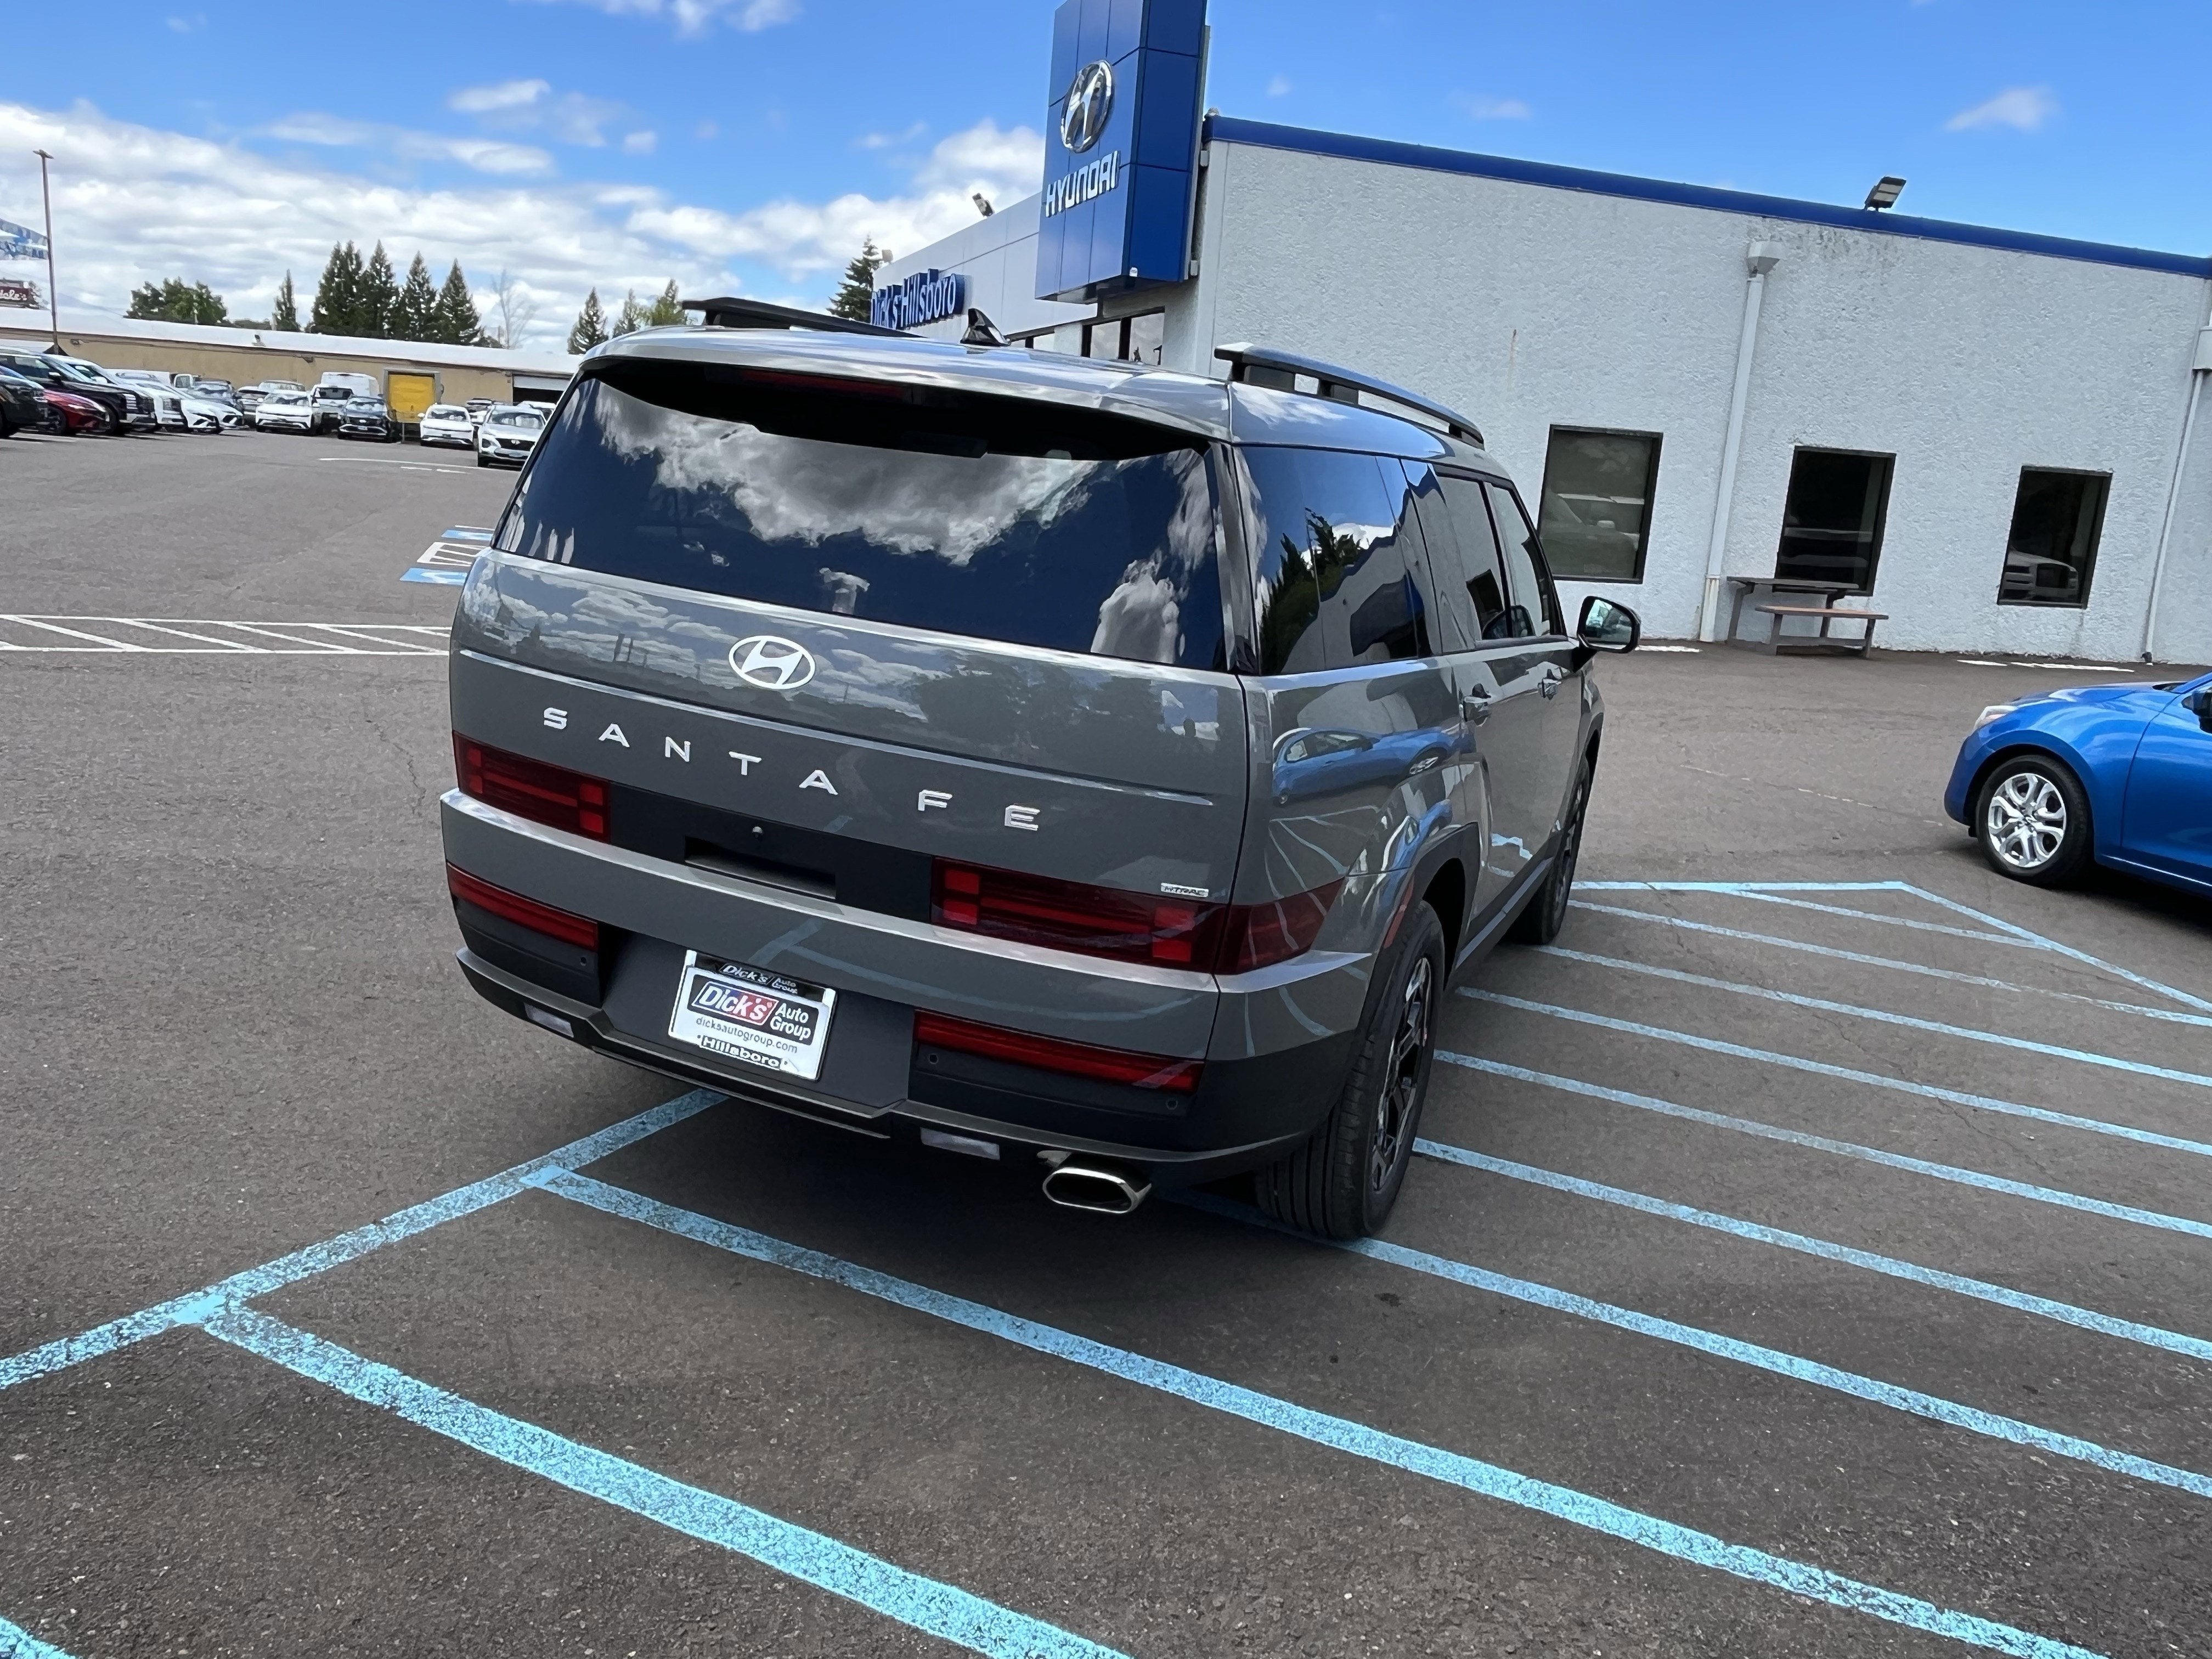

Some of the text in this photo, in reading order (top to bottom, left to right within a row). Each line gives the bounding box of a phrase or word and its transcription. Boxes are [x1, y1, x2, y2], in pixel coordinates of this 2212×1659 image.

[1046, 150, 1118, 217] HYUNDAI
[901, 269, 956, 328] Hillsboro
[543, 707, 1041, 831] SANTA FE
[723, 964, 769, 985] Dick's
[698, 985, 768, 1020] Dick's
[775, 1002, 809, 1023] Auto
[696, 1017, 798, 1054] dicksautogroup.com
[770, 1015, 811, 1041] Group
[702, 1035, 780, 1068] Hillsboro
